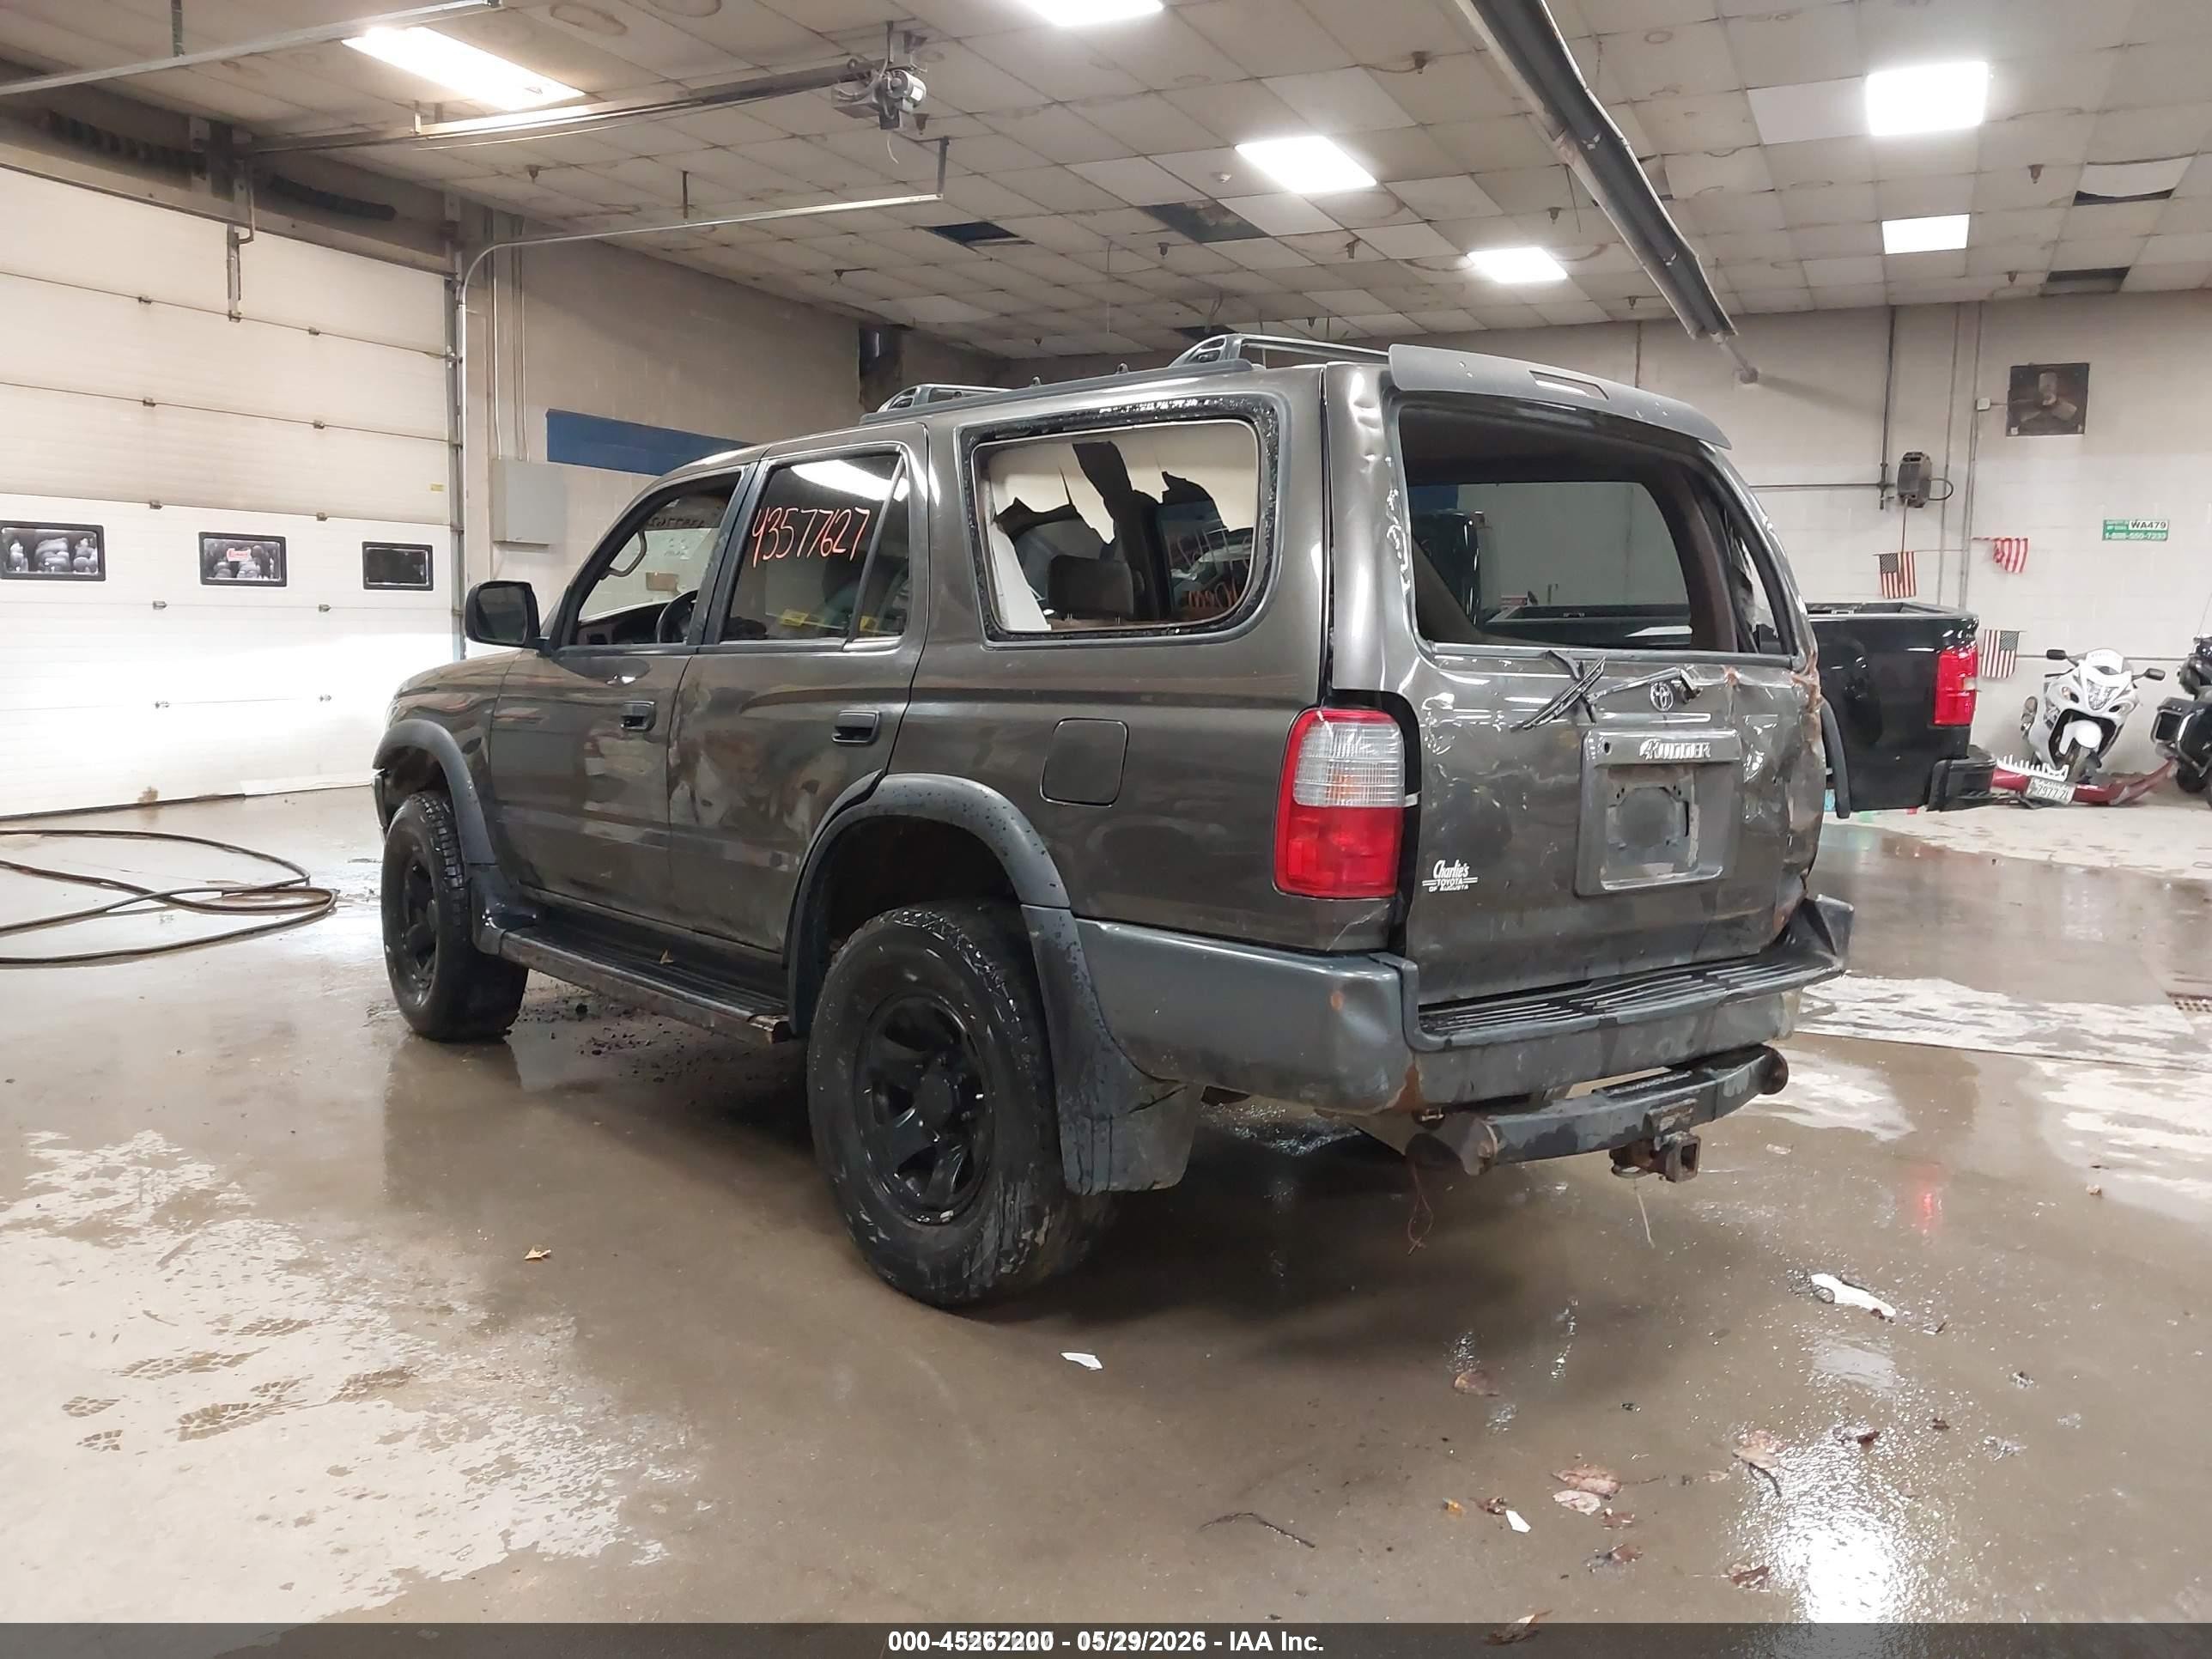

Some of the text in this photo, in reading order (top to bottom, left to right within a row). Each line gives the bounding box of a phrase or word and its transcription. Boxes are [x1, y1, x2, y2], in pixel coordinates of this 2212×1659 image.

[751, 507, 871, 568] 43577627
[1432, 860, 1470, 879] Charlie's
[1437, 878, 1463, 886] TOYOTA
